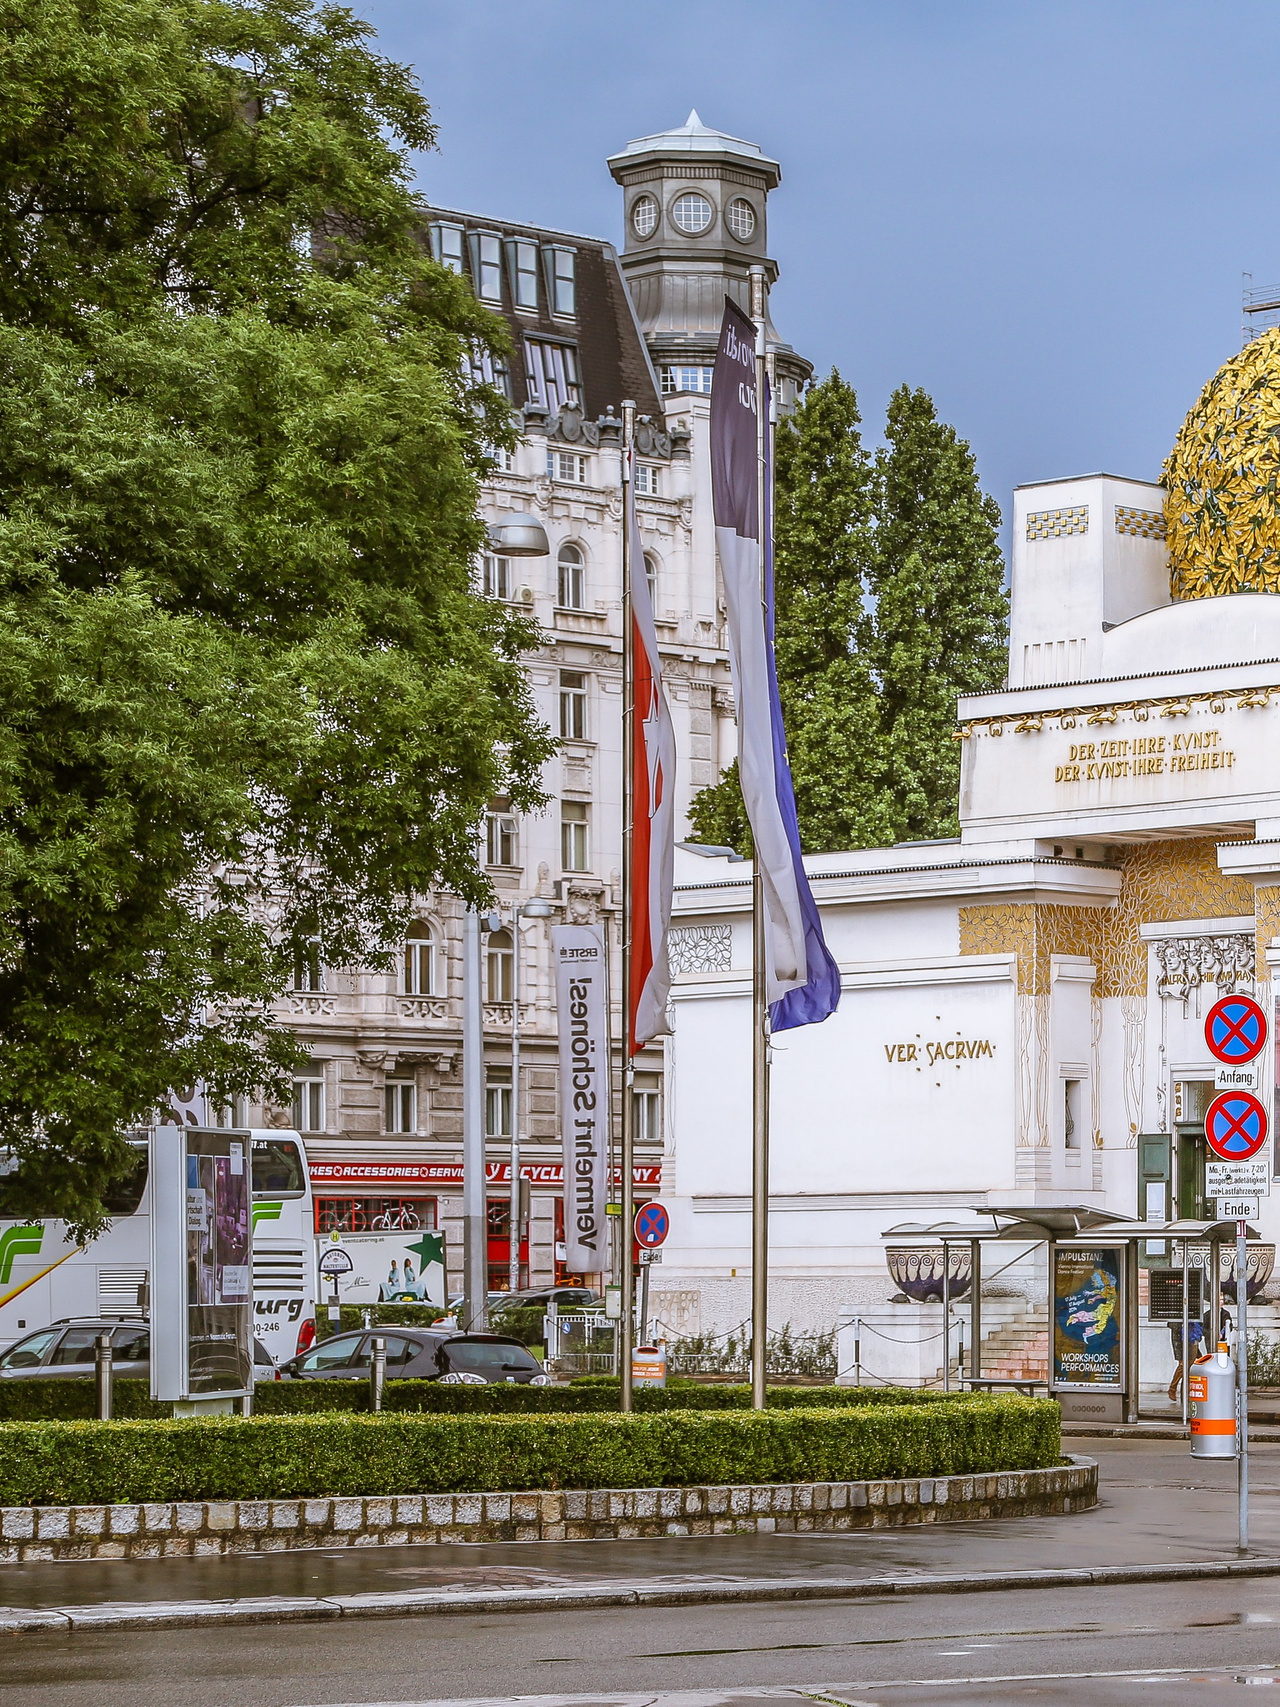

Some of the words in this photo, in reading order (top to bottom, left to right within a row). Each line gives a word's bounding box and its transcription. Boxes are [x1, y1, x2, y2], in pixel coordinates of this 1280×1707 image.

[884, 1043, 918, 1063] VER
[1219, 1069, 1253, 1086] Anfang
[343, 1167, 419, 1178] ACCESSORIES
[1222, 1187, 1265, 1197] Lastfahrzeugen
[1224, 1202, 1251, 1216] Ende
[1058, 1252, 1104, 1262] IMPULSTANZ
[1061, 1352, 1109, 1363] WORKSHOPS
[1060, 1362, 1120, 1373] PERFORMANCES
